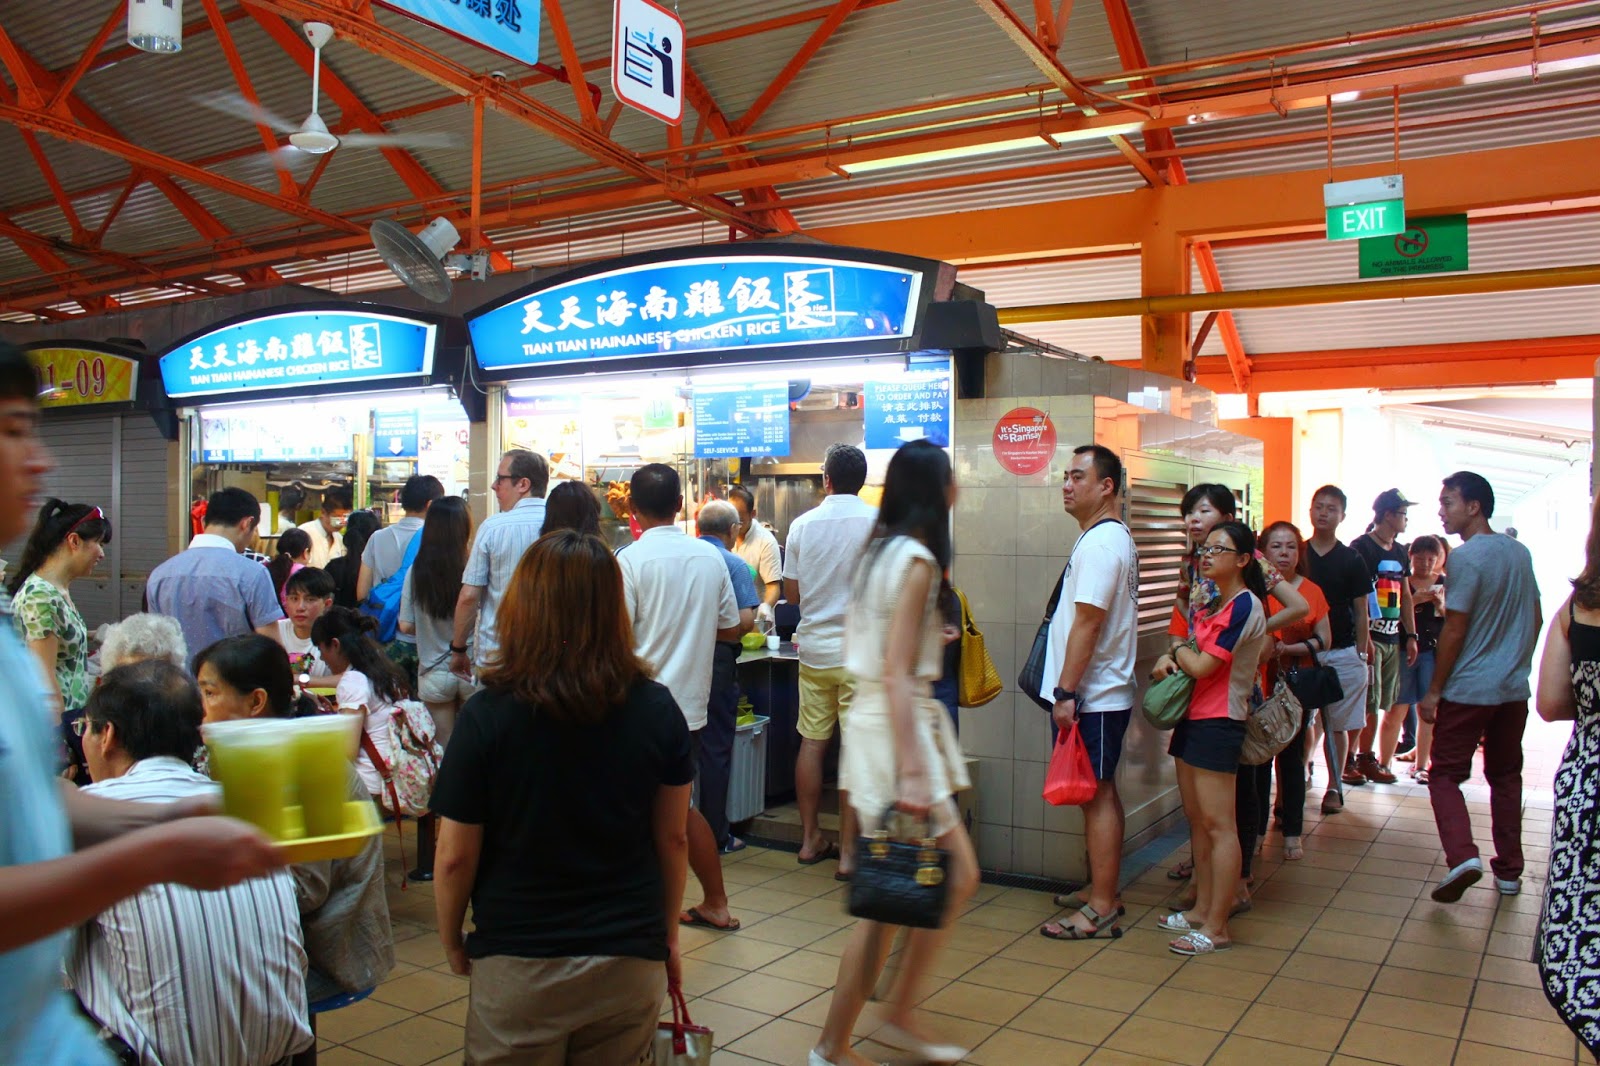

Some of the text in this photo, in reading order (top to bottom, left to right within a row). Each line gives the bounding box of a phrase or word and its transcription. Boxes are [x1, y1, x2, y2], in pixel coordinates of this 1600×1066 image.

[1342, 206, 1387, 233] EXIT
[1385, 258, 1416, 267] ANIMALS
[1418, 256, 1453, 264] ALLOWED
[522, 320, 780, 356] TIAN TIAN HAINANESE CHICKEN RICE
[190, 360, 350, 385] TIAN TIAN HAINANESE CHICKEN RICE
[875, 381, 948, 392] PLEASE QUEUE HER
[887, 392, 912, 400] ORDER
[914, 392, 931, 400] AND
[933, 391, 948, 399] PAY
[881, 401, 944, 412] 请在此排队
[1012, 424, 1047, 434] Singapore
[1009, 433, 1041, 443] Ramsay
